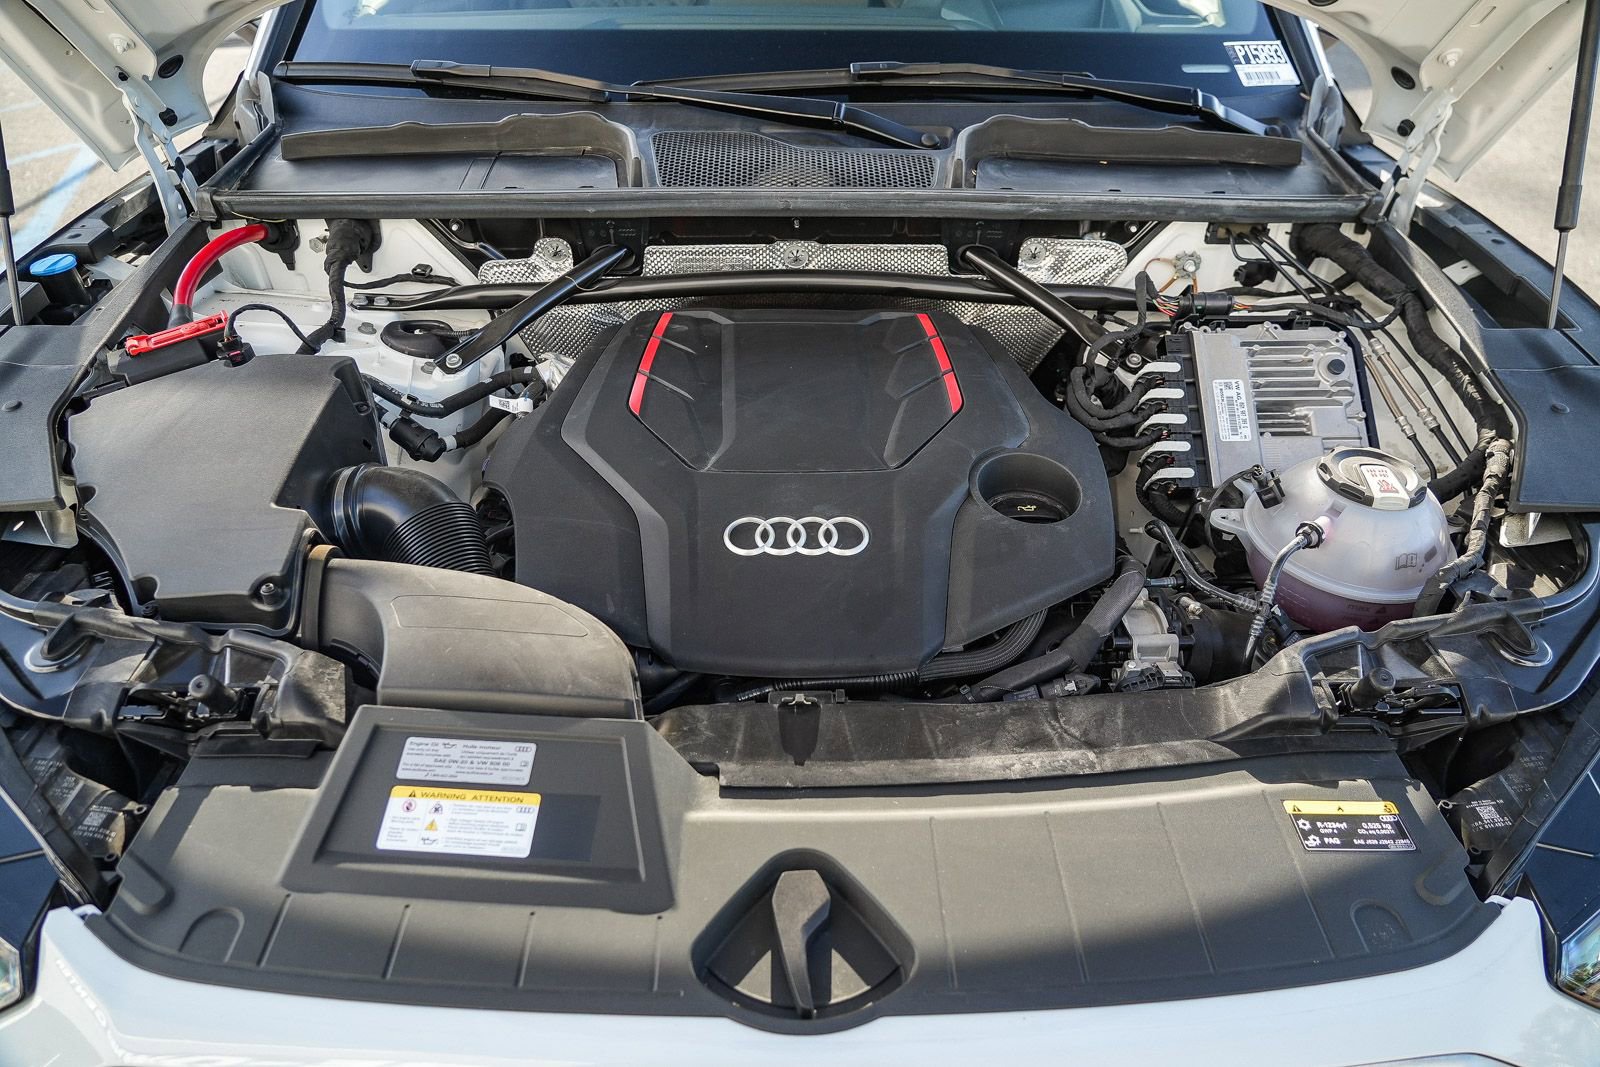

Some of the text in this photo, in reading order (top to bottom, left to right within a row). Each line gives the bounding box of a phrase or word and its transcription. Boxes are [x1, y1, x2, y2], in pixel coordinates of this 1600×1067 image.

[1234, 44, 1287, 65] P15893
[420, 791, 524, 804] WARNING ATTENTION
[1382, 822, 1393, 831] kg
[1323, 837, 1341, 845] PAG
